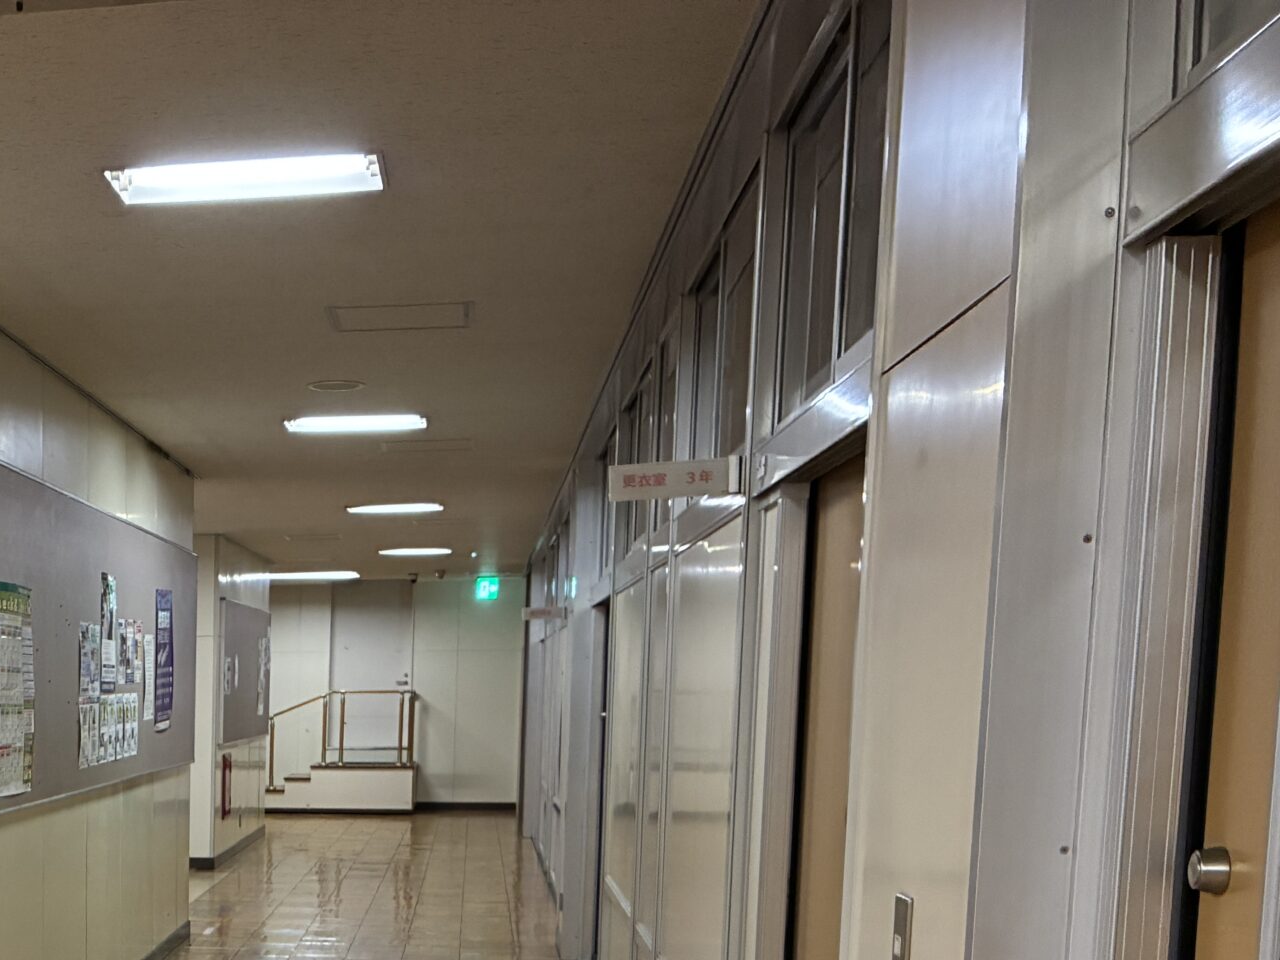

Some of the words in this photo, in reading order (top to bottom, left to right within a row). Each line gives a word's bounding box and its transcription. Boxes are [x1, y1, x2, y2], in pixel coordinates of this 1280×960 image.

[623, 473, 667, 488] 更衣室
[686, 470, 713, 485] 3年
